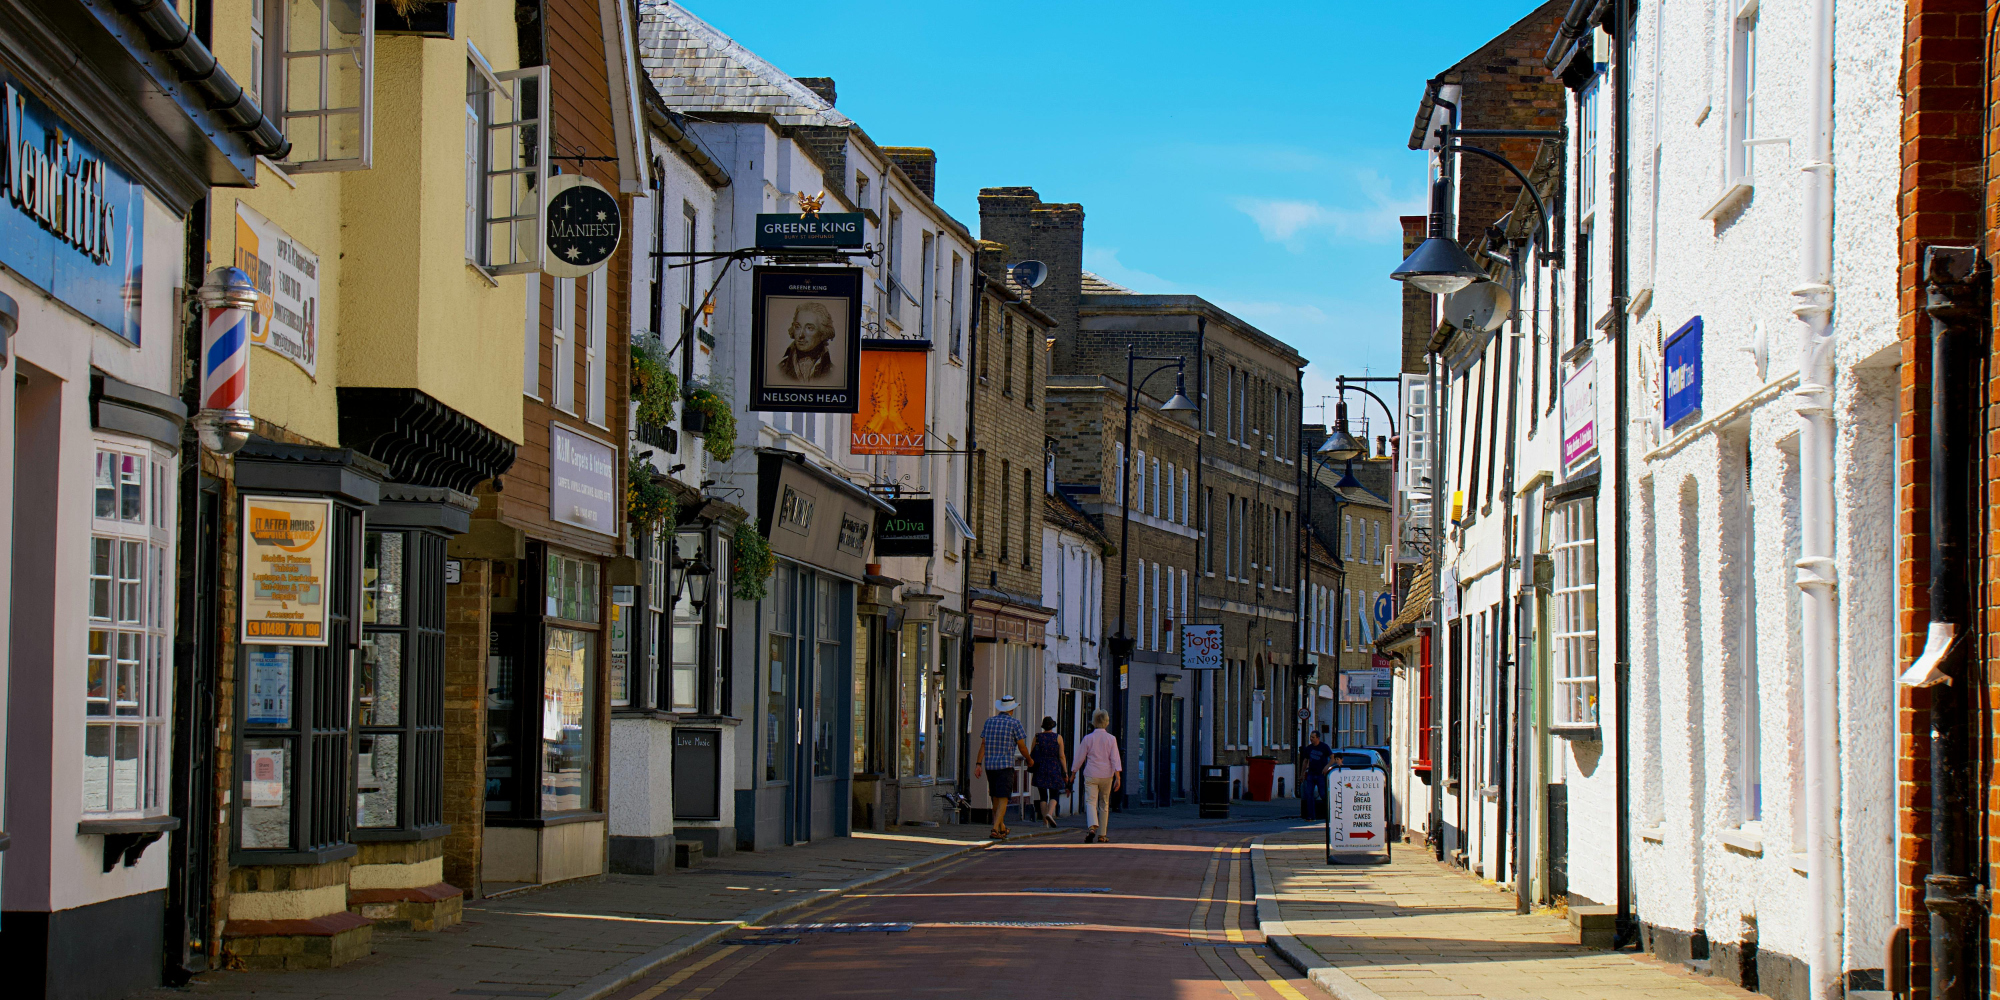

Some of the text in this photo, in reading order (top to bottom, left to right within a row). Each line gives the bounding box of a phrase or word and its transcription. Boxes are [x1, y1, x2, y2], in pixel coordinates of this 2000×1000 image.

[5, 81, 114, 266] Venditti's
[551, 220, 616, 237] MANIFEST
[764, 222, 856, 233] GREENE KING
[1668, 355, 1686, 399] Premier
[763, 392, 847, 403] NELSONS HEAD
[852, 433, 923, 446] MONTAZ
[571, 446, 589, 471] Carpets
[594, 455, 612, 478] Interiors
[256, 518, 315, 531] IT AFTER HOURS
[885, 519, 924, 531] A'Diva
[261, 554, 311, 563] Mobile Phones
[274, 564, 299, 572] Tablets
[253, 573, 280, 583] Laptops
[288, 574, 318, 584] Desktops
[272, 592, 296, 602] Repairs
[266, 610, 304, 619] Accessories
[261, 622, 319, 636] 01480 700 190
[1185, 632, 1219, 655] toys
[677, 737, 710, 746] Live Music
[1335, 823, 1343, 841] Di
